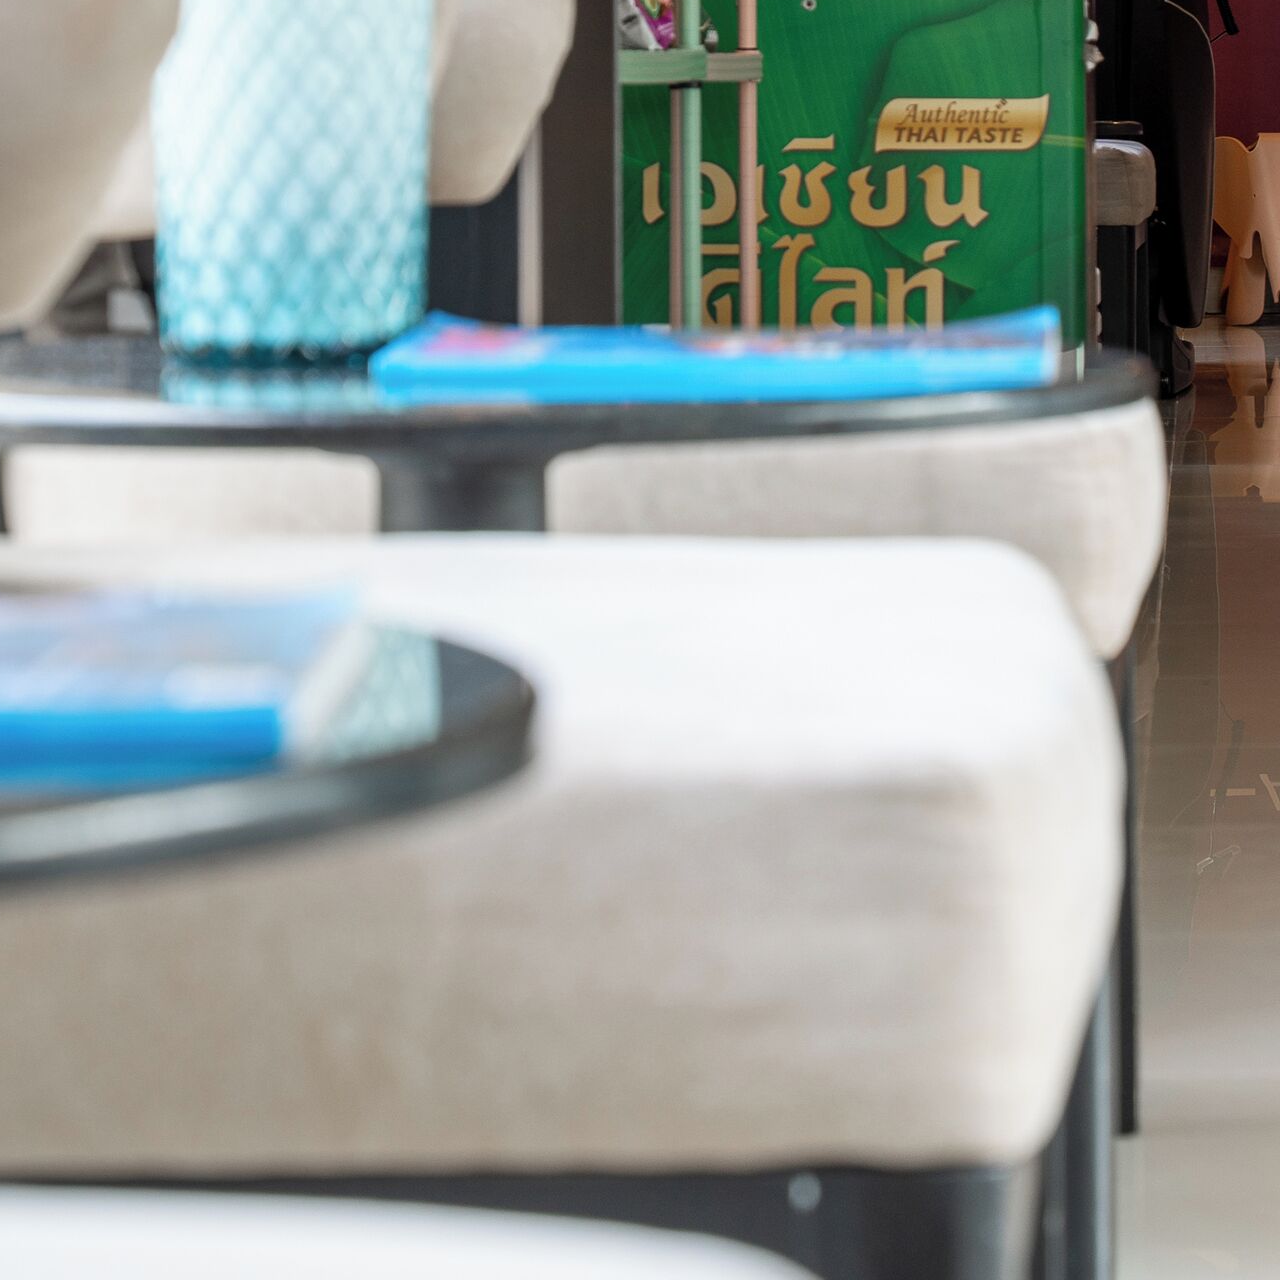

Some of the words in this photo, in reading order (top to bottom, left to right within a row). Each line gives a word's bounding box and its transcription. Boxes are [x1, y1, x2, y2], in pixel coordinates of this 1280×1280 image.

[899, 100, 1010, 125] Authentic
[894, 126, 948, 144] THAI
[954, 126, 1024, 144] TASTE
